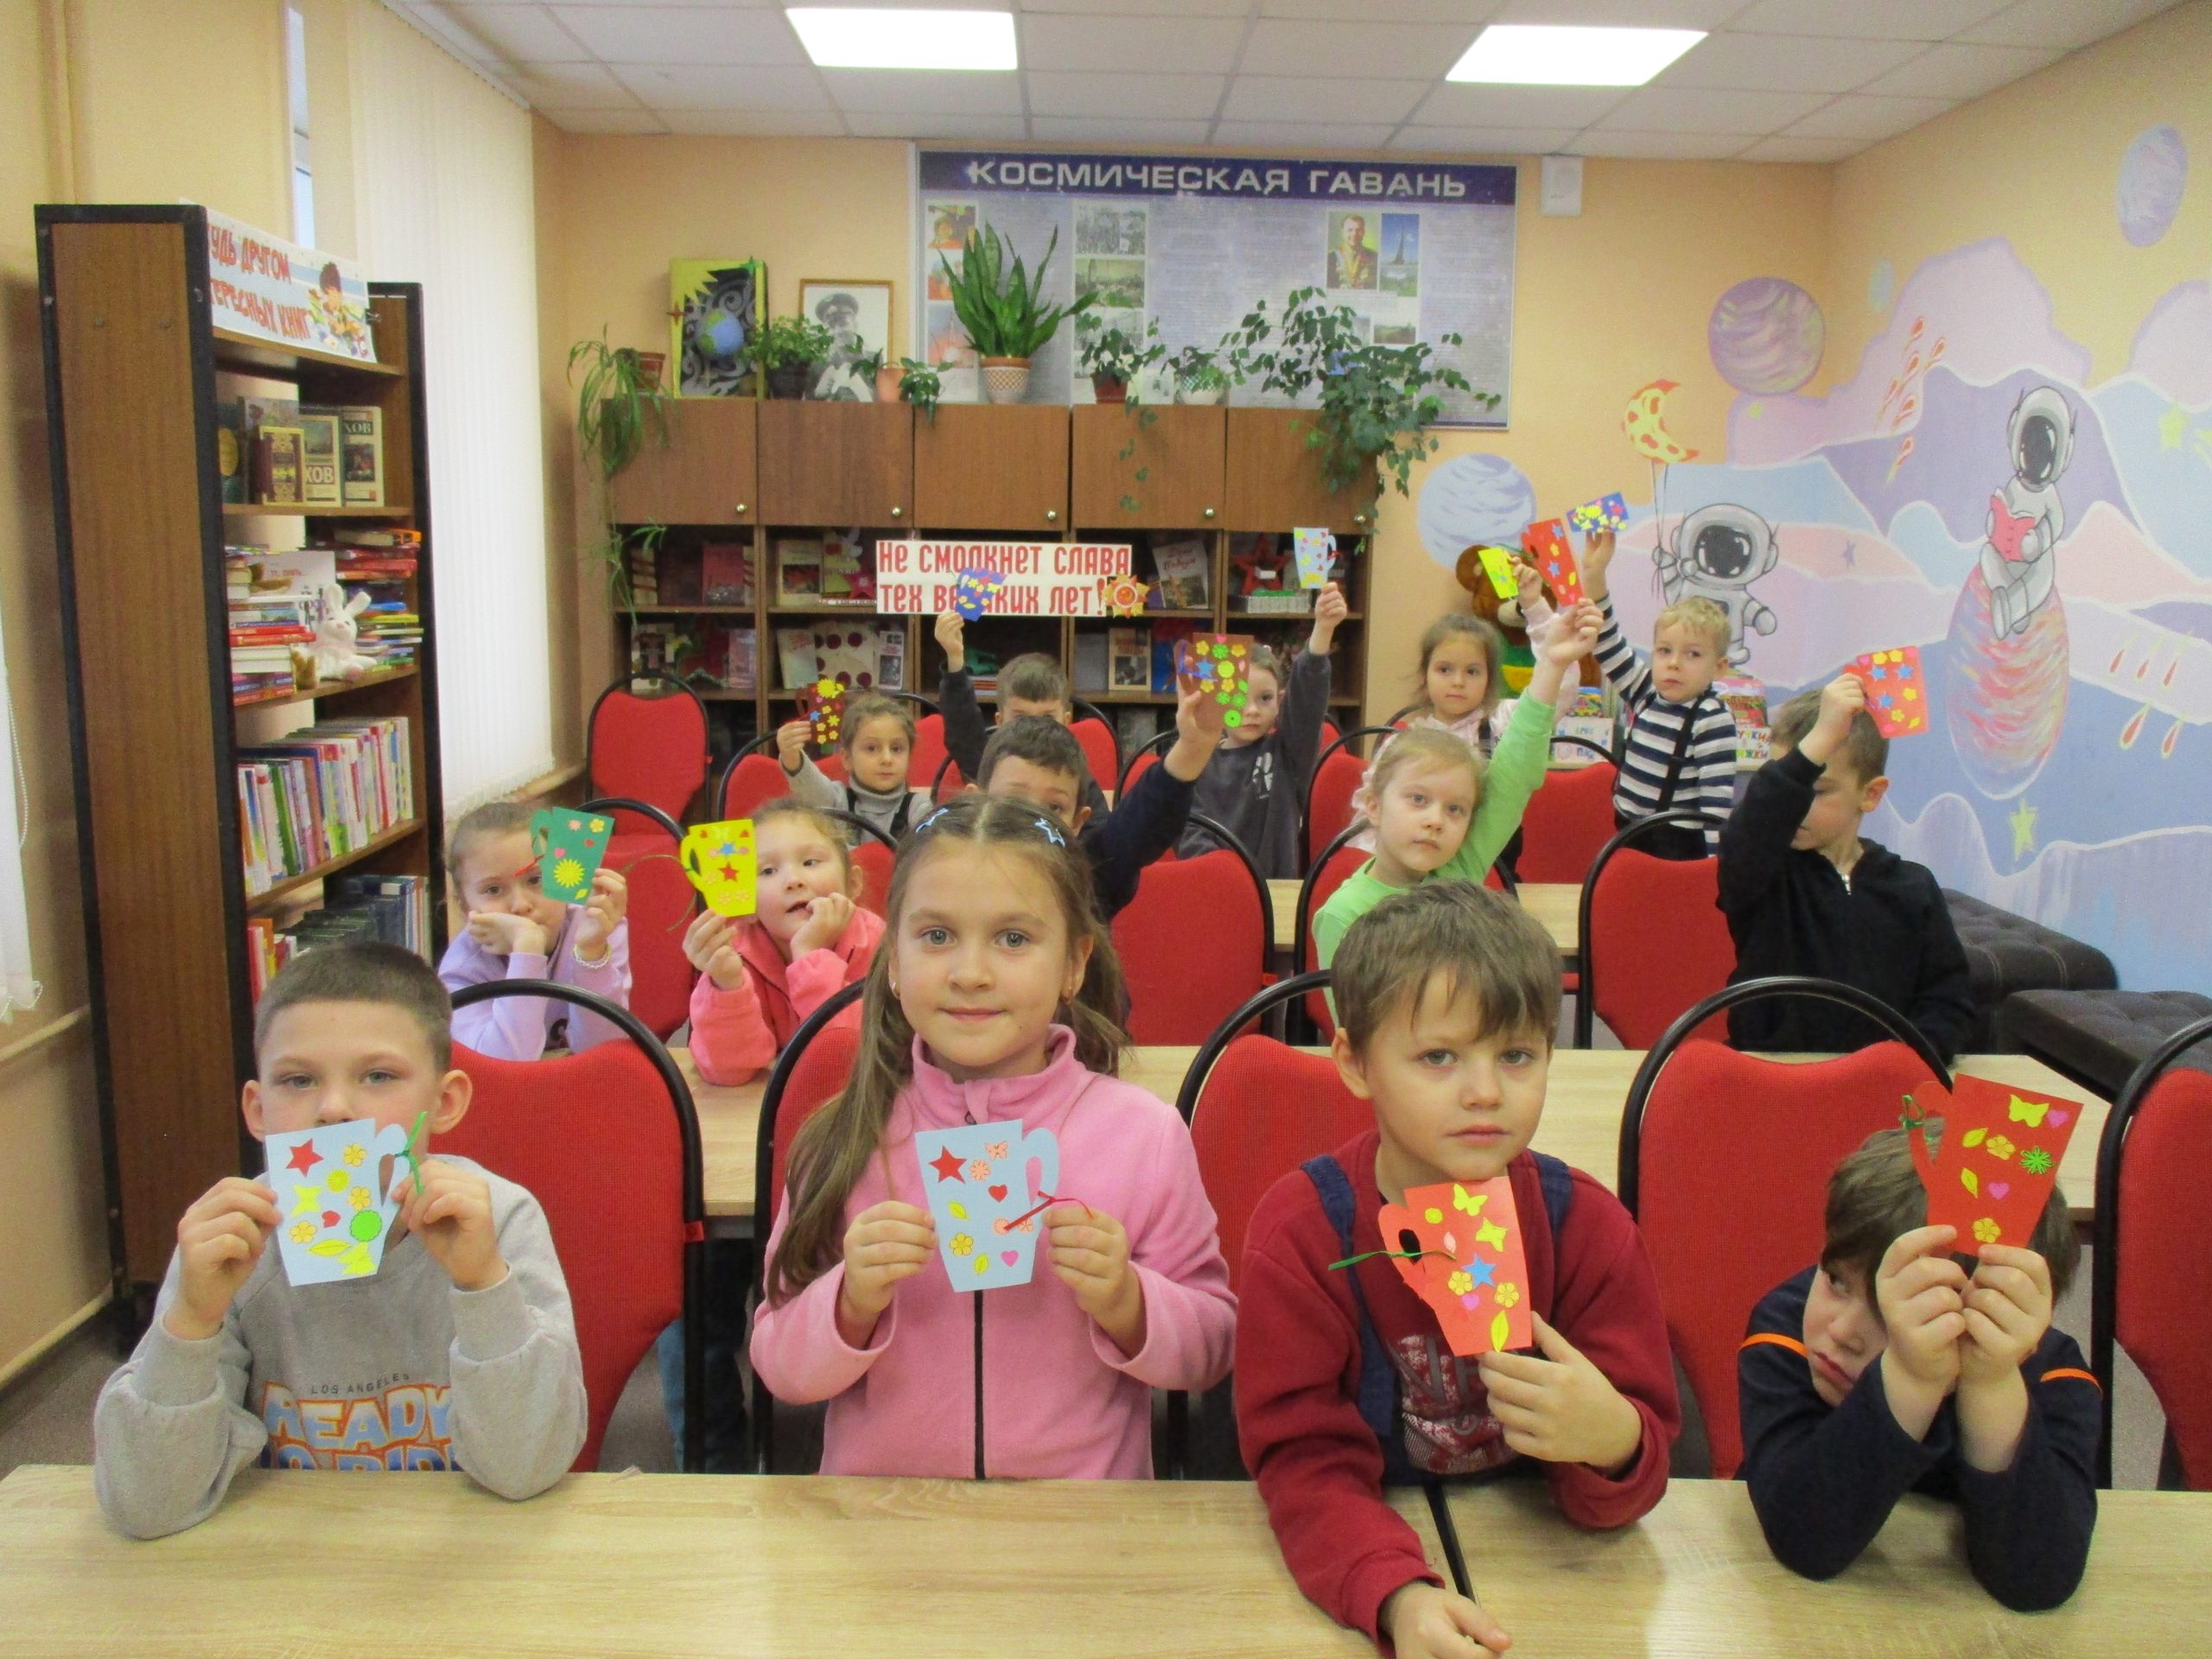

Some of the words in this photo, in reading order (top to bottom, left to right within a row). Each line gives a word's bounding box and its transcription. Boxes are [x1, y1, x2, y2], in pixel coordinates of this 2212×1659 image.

[969, 160, 1290, 194] КОСМИЧЕСКАЯ
[1308, 169, 1466, 198] ГАВАНЬ
[208, 226, 237, 268] УДЬ
[241, 238, 292, 283] ДРУГОМ
[310, 1383, 340, 1395] LOS
[347, 1372, 410, 1395] ANGELES
[262, 1381, 453, 1452] READY
